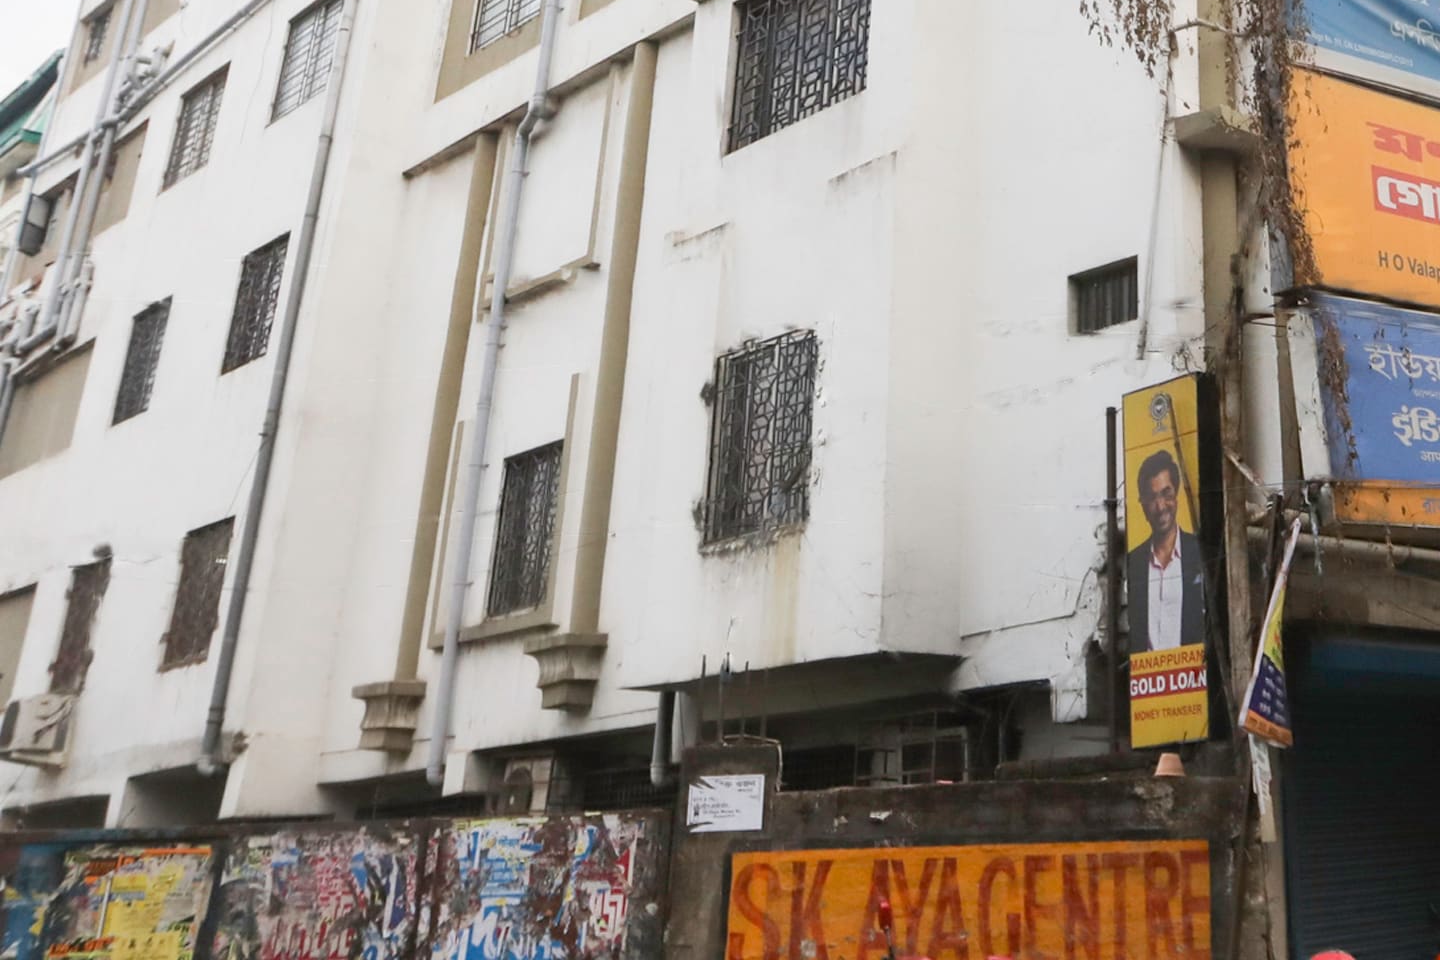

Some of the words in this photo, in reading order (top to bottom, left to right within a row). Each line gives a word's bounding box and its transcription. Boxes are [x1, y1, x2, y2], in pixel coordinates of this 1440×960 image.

[1378, 251, 1389, 268] H
[1393, 254, 1404, 271] O
[1130, 648, 1206, 672] MANAPPURAM
[1130, 674, 1166, 696] GOLD
[1169, 670, 1208, 691] LOAN
[1161, 703, 1202, 719] TRANSFER
[724, 859, 834, 960] SK
